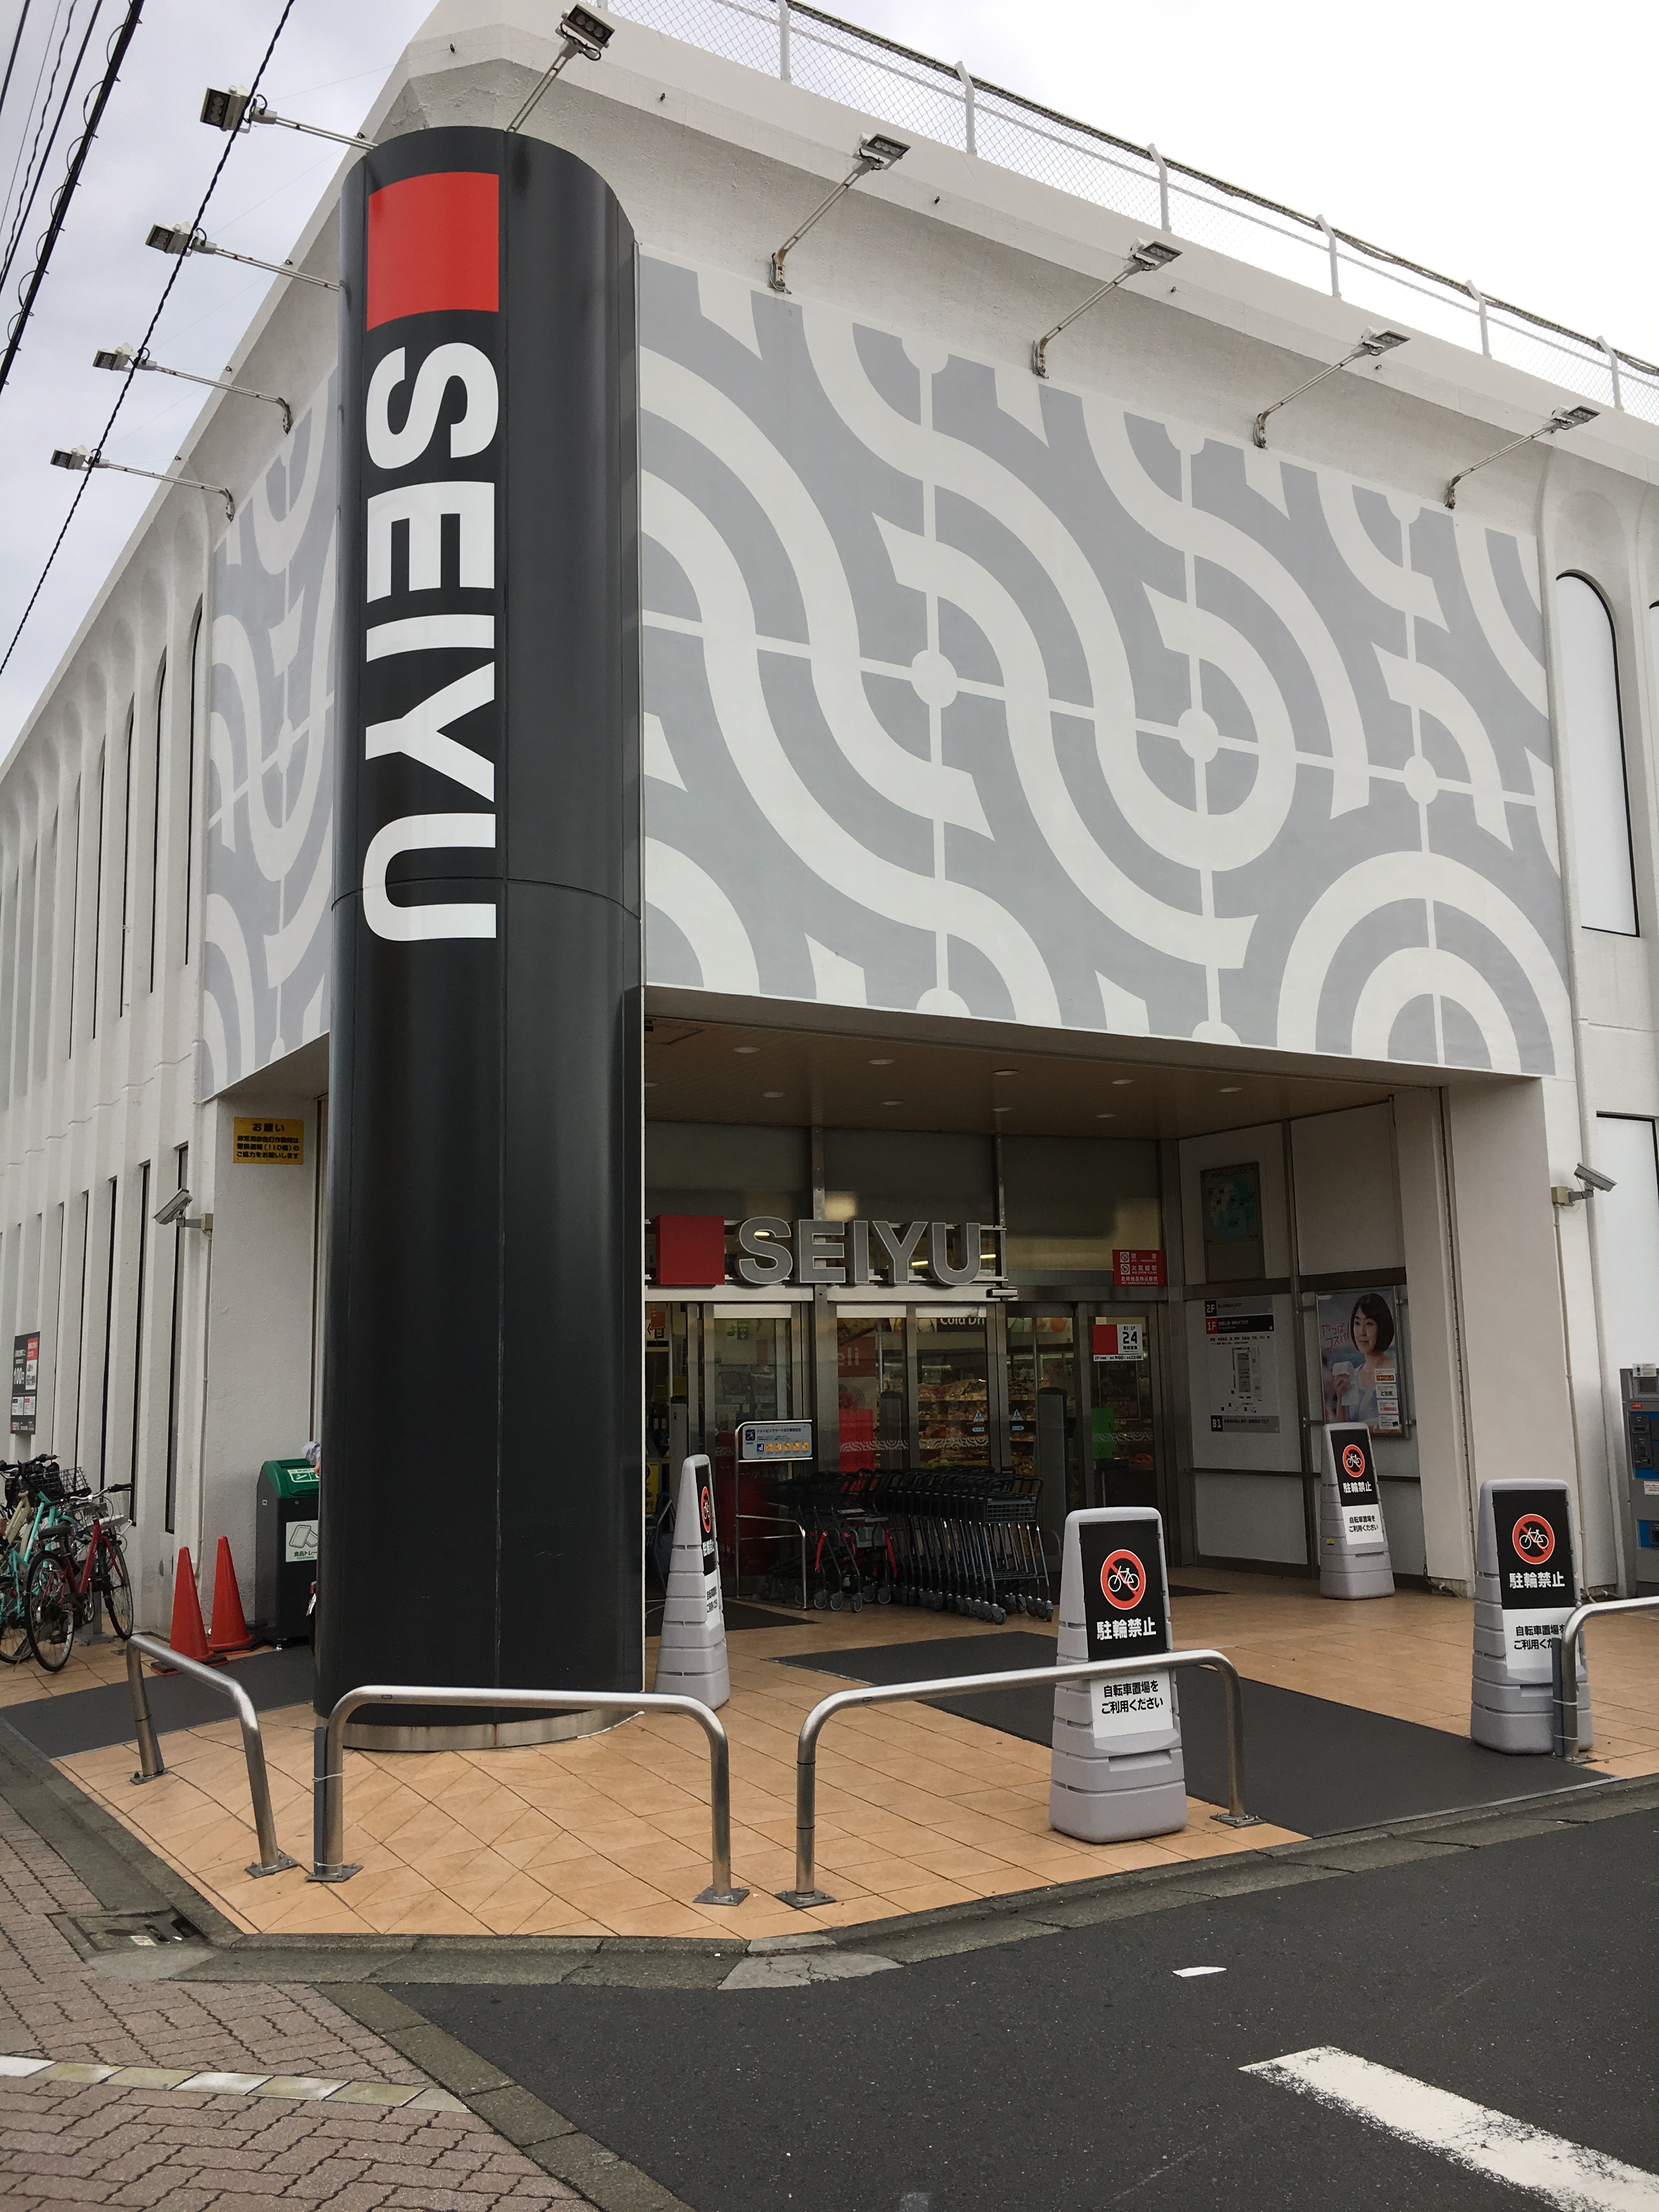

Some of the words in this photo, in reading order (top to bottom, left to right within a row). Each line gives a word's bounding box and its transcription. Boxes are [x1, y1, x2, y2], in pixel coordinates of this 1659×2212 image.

[363, 342, 499, 941] SEIYU
[253, 1123, 285, 1132] お願い
[738, 1216, 981, 1285] SEIYU
[1206, 1304, 1215, 1313] 2F
[1207, 1321, 1216, 1331] 1F
[1122, 1331, 1137, 1344] 24
[838, 1347, 859, 1366] eli
[1212, 1419, 1222, 1428] B1
[1342, 1481, 1373, 1493] 駐輪禁止
[1349, 1515, 1376, 1524] 自転車置場を
[1348, 1524, 1379, 1533] ご利用ください
[1509, 1571, 1565, 1589] 駐輪禁止
[1096, 1616, 1156, 1641] 駐輪禁止
[1103, 1680, 1159, 1699] 自転車置場を
[1101, 1697, 1164, 1714] ご利用ください
